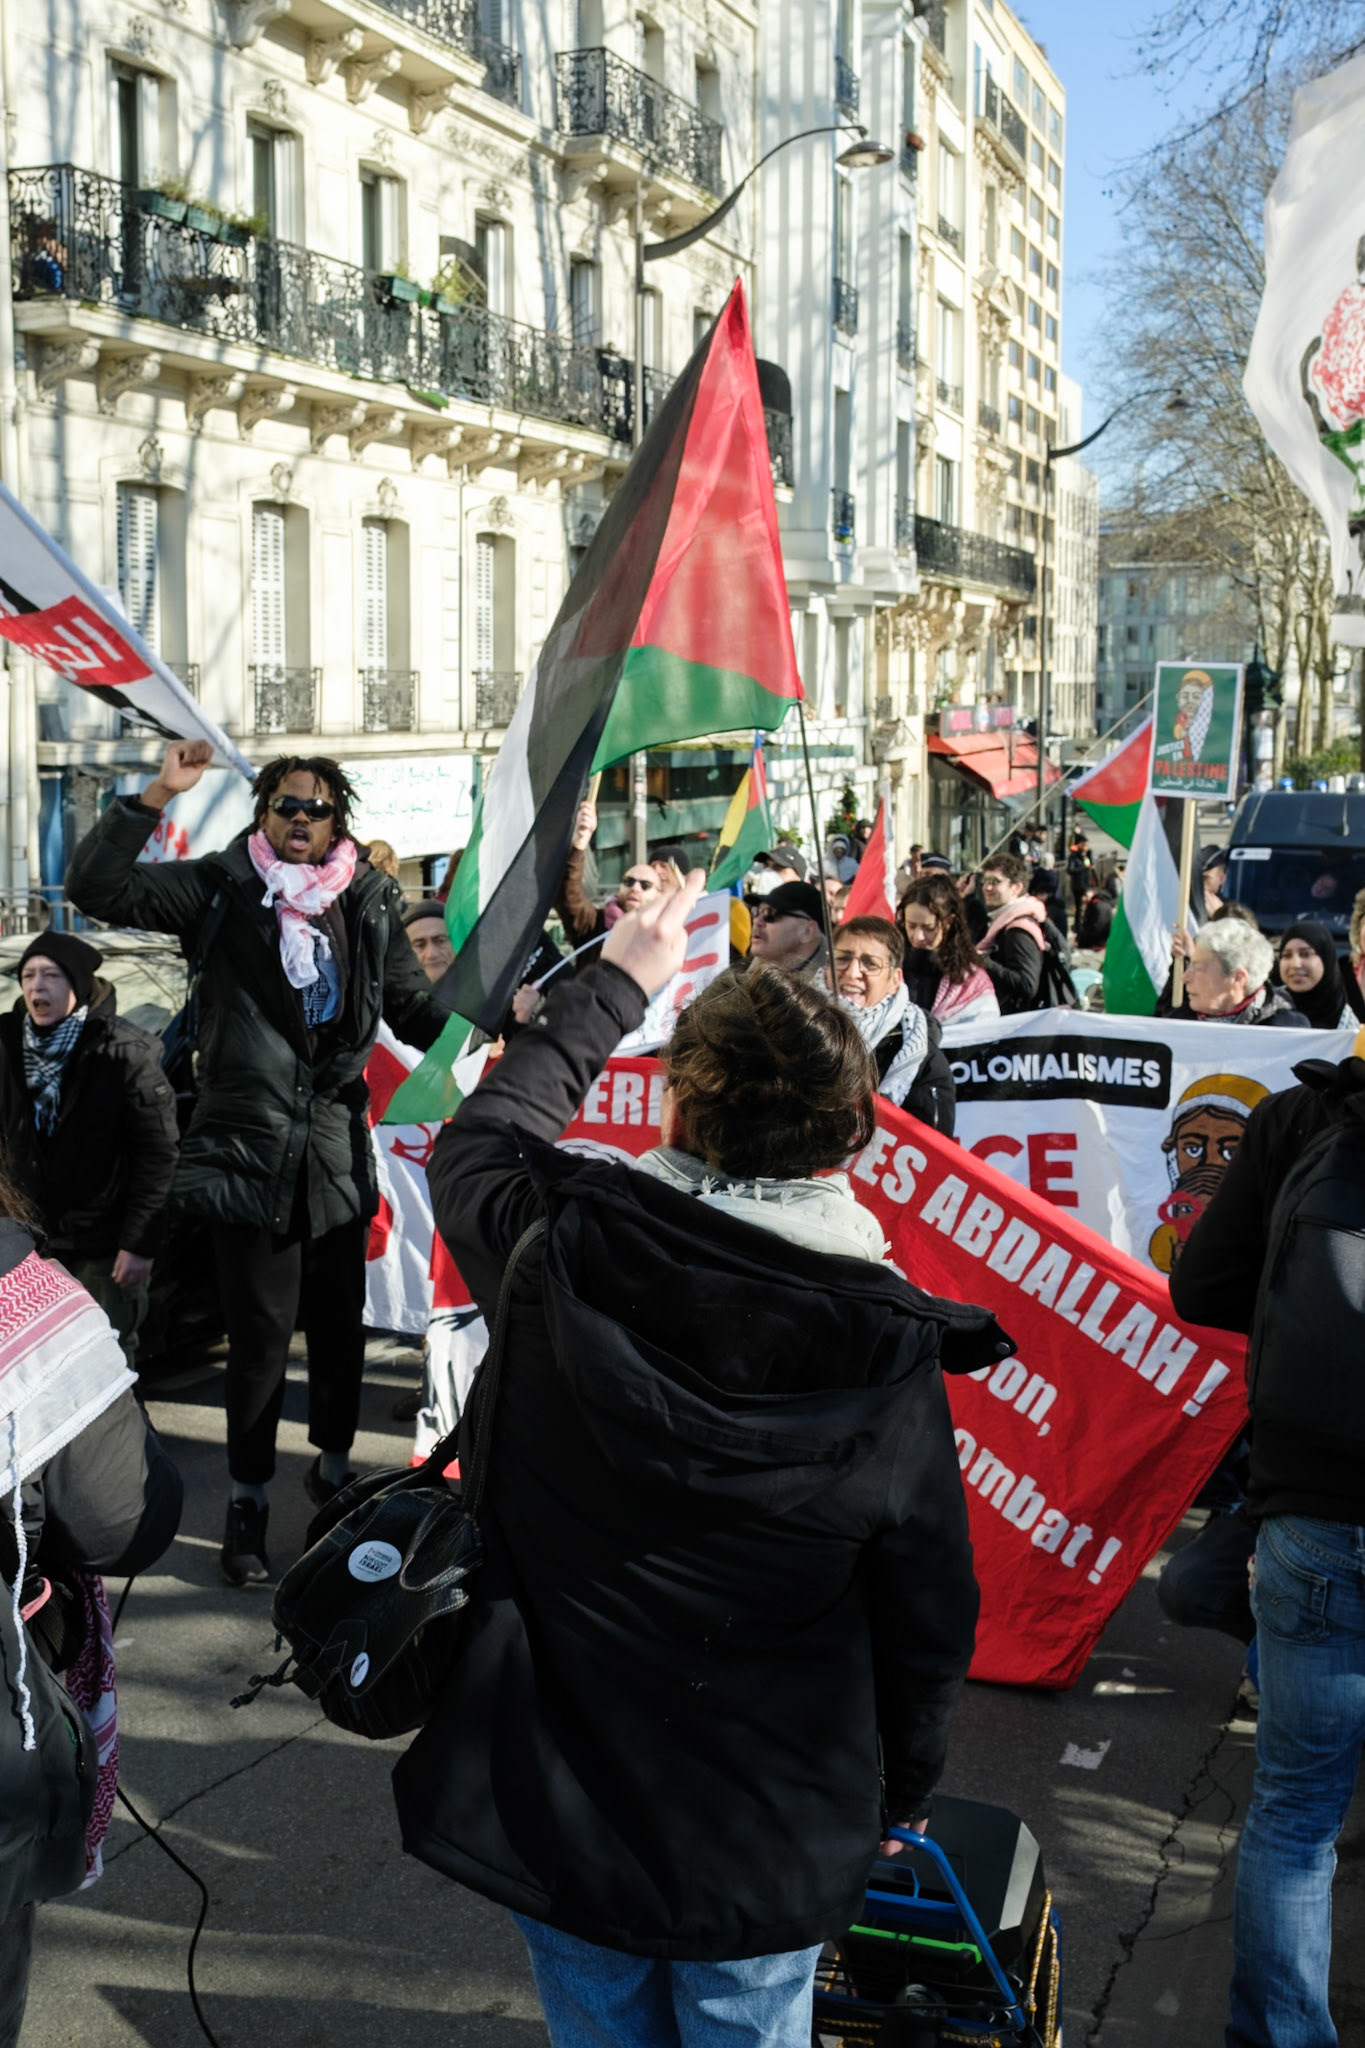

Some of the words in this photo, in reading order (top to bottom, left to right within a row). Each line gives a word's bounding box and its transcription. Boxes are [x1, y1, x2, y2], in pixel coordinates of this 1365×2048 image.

[1154, 760, 1228, 781] PALESTINE
[950, 1053, 1161, 1088] OLONIALISMES
[845, 1126, 928, 1205] ES
[919, 1174, 1198, 1396] ABDALLAH
[968, 1356, 1058, 1437] on,
